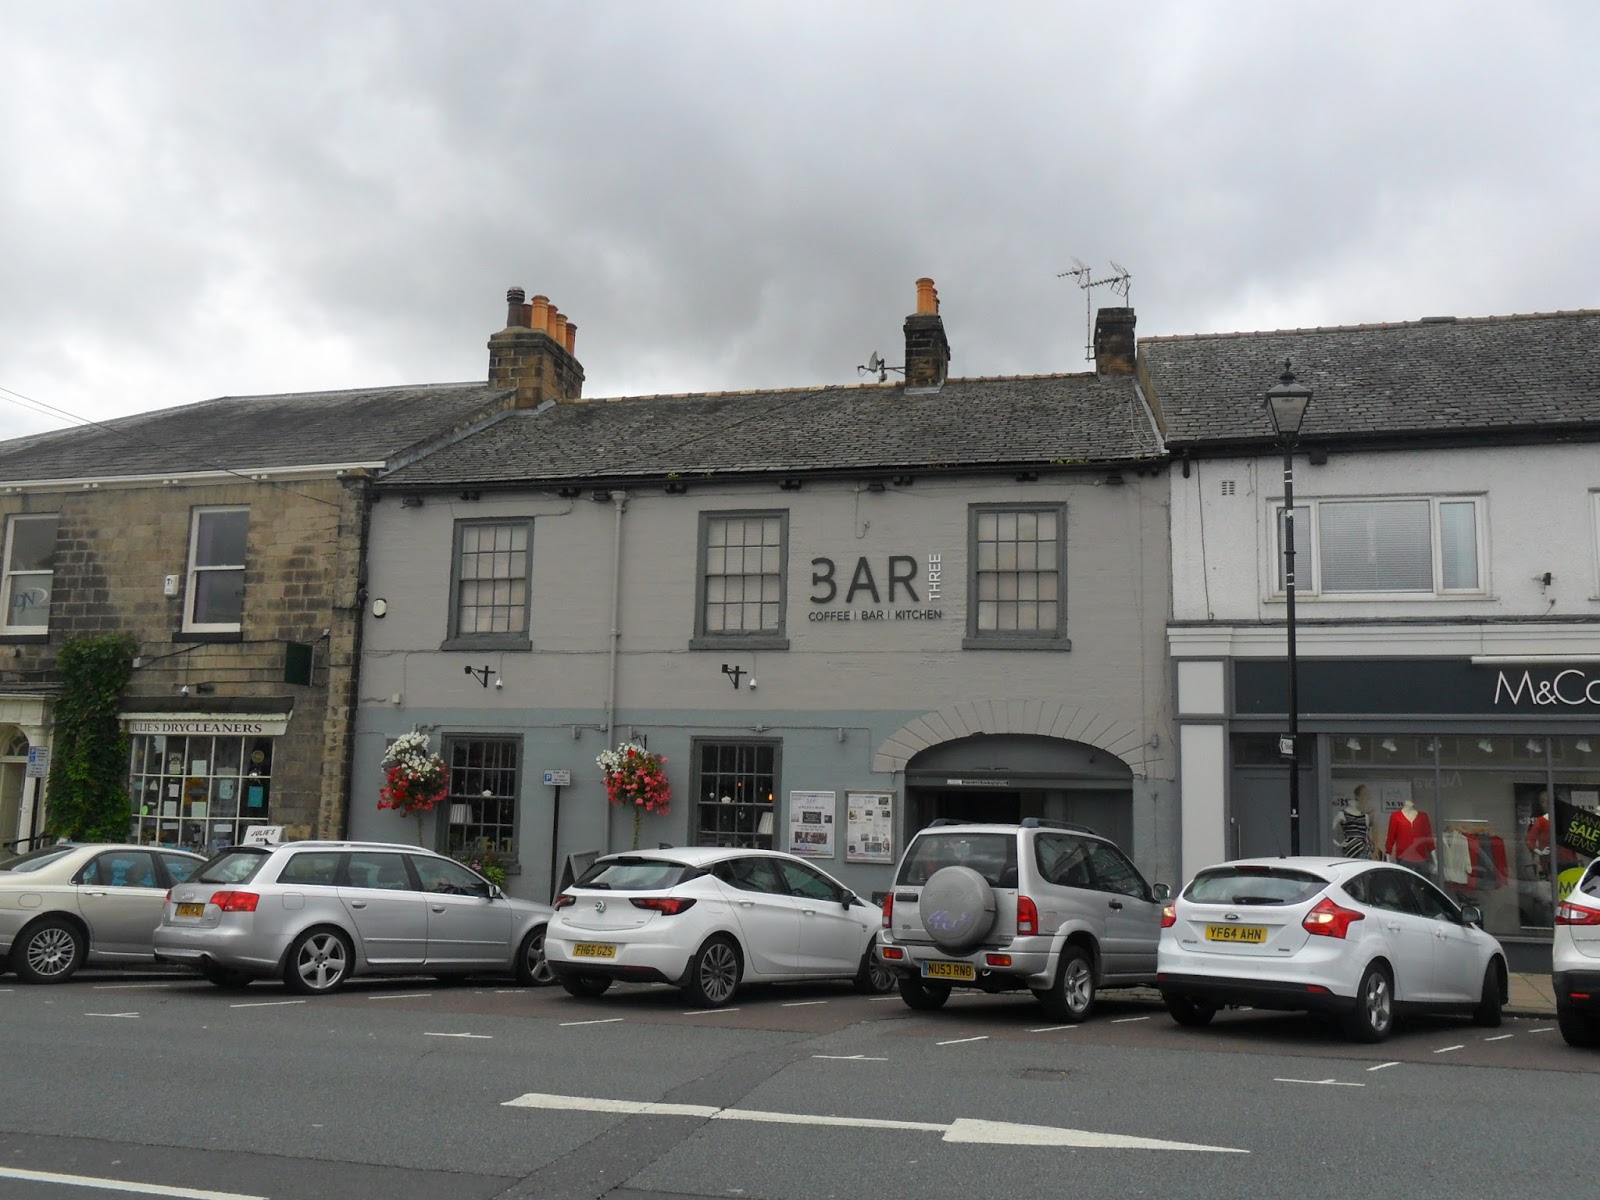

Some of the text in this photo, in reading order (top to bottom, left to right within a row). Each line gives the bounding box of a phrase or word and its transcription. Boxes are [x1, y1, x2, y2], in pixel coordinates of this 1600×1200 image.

[928, 554, 941, 602] THREE
[808, 609, 942, 622] COFFEE BAR KITCHEN
[1494, 669, 1600, 705] M&Co
[132, 722, 262, 733] JULIE'S DRYCLEANERS
[251, 829, 276, 837] JULIE'S
[1569, 821, 1600, 842] SALE
[1564, 832, 1597, 852] ITEMS
[1210, 927, 1262, 940] YF64 AHN
[576, 945, 613, 956] FH65 GZS
[928, 963, 952, 975] NU53
